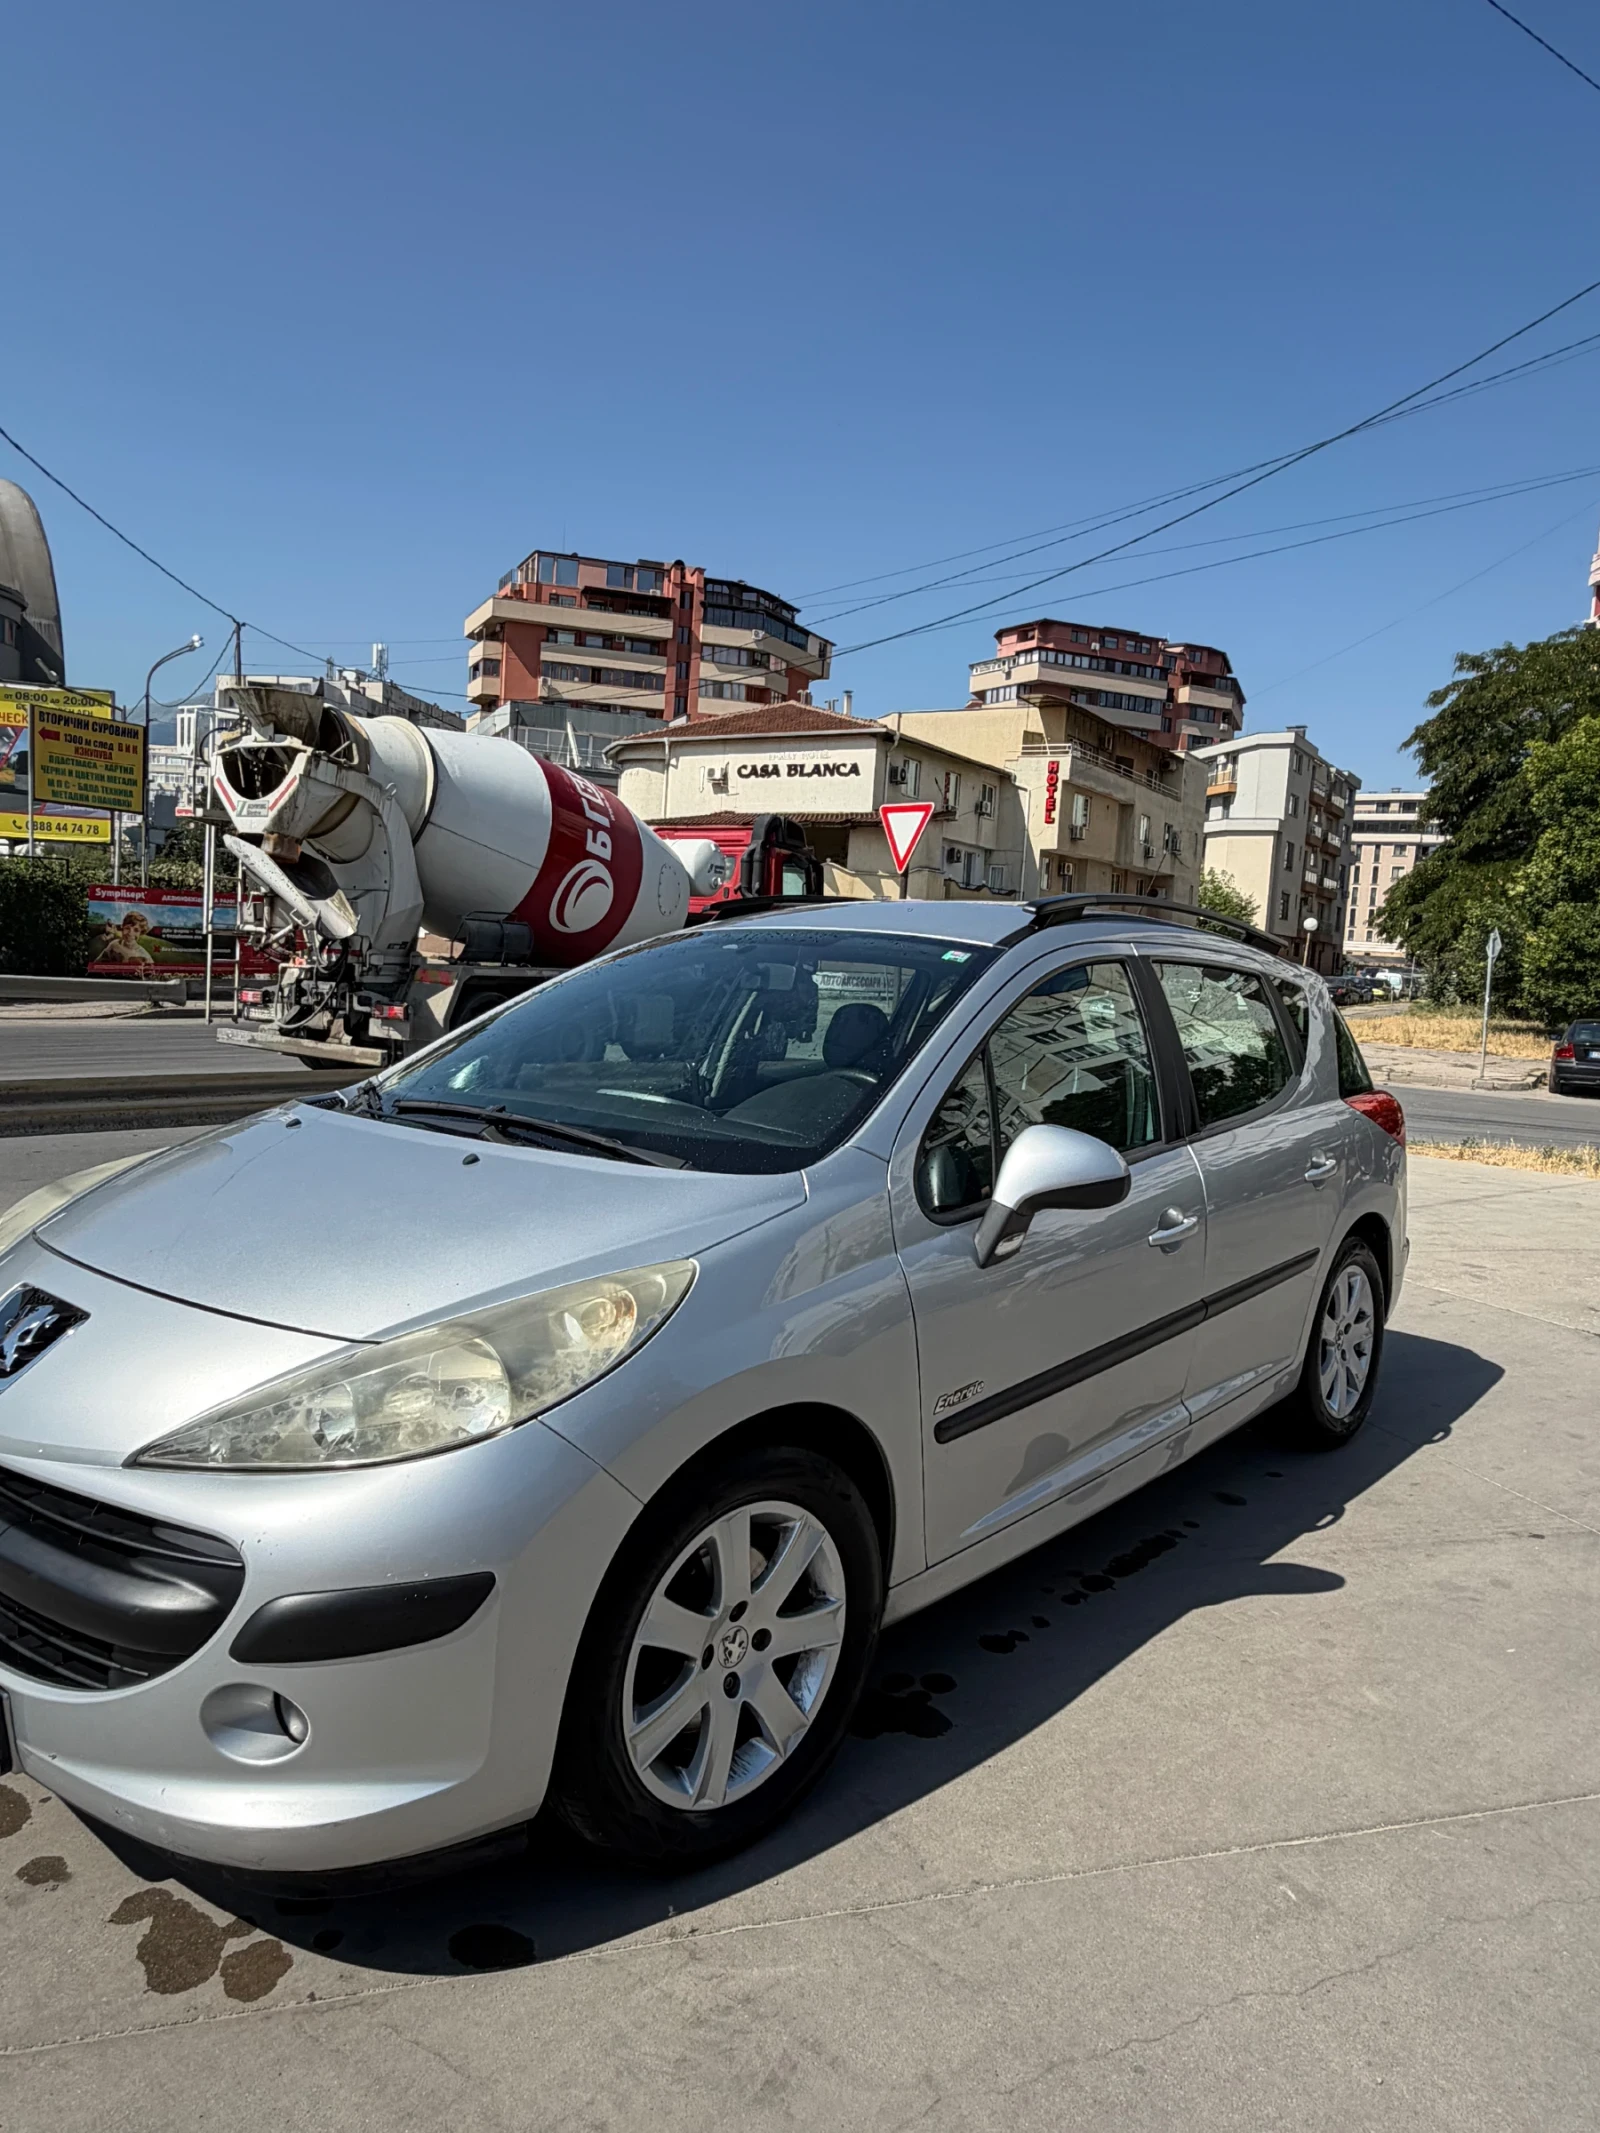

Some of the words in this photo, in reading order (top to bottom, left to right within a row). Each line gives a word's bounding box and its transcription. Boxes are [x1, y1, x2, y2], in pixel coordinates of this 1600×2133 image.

[15, 691, 48, 702] 08:00
[63, 696, 95, 707] 20:00
[39, 710, 90, 731] ВТОРИЧНИ
[92, 721, 139, 740] СУРОВИНИ
[74, 746, 113, 760] ИЗКУПУВА
[48, 755, 98, 769] ПЛАСТМАСА
[104, 763, 135, 775] ХАРТИЯ
[737, 763, 782, 779] CASA
[786, 762, 861, 778] BLANCA
[40, 764, 66, 776] ЧЕРНИ
[107, 774, 138, 787] МЕТАЛИ
[51, 789, 90, 802] МЕТАЛНИ
[77, 782, 100, 793] БЯЛА
[101, 785, 134, 798] ТЕХНИКА
[1044, 760, 1060, 824] HOTEL
[55, 822, 68, 833] 44
[71, 823, 83, 834] 74
[86, 824, 99, 835] 78
[933, 1380, 985, 1415] Energie
